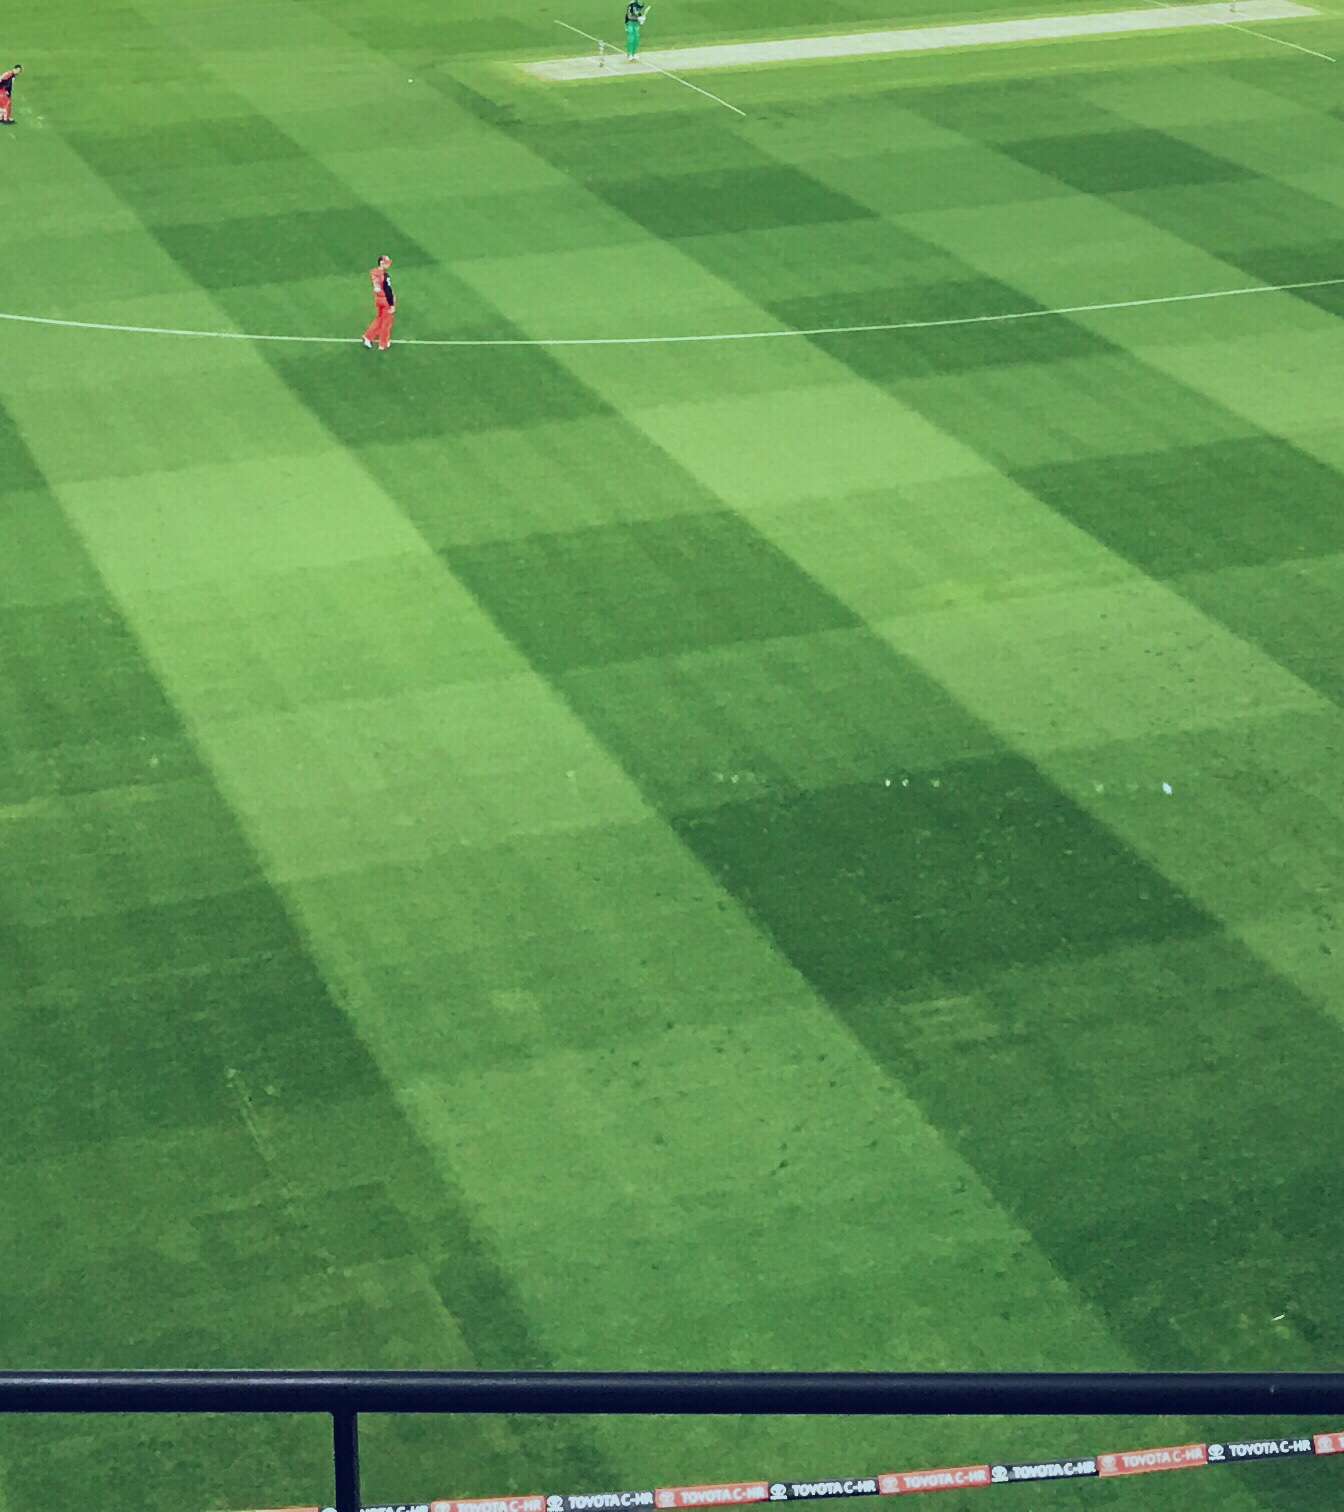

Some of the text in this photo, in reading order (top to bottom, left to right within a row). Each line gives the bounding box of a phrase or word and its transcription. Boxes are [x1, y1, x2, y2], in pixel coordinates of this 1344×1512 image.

[1228, 1438, 1311, 1457] TOYOTA C-HR
[1122, 1448, 1203, 1468] TOYOTA C-HR
[1012, 1460, 1096, 1479] TOYOTA C-HR
[792, 1480, 876, 1497] TOYOTA C-HR
[904, 1471, 986, 1490] TOYOTA C-HR
[568, 1492, 654, 1510] TOYOTA C-HR
[681, 1486, 766, 1504] TOYOTA C-HR
[510, 1500, 542, 1512] C-HR
